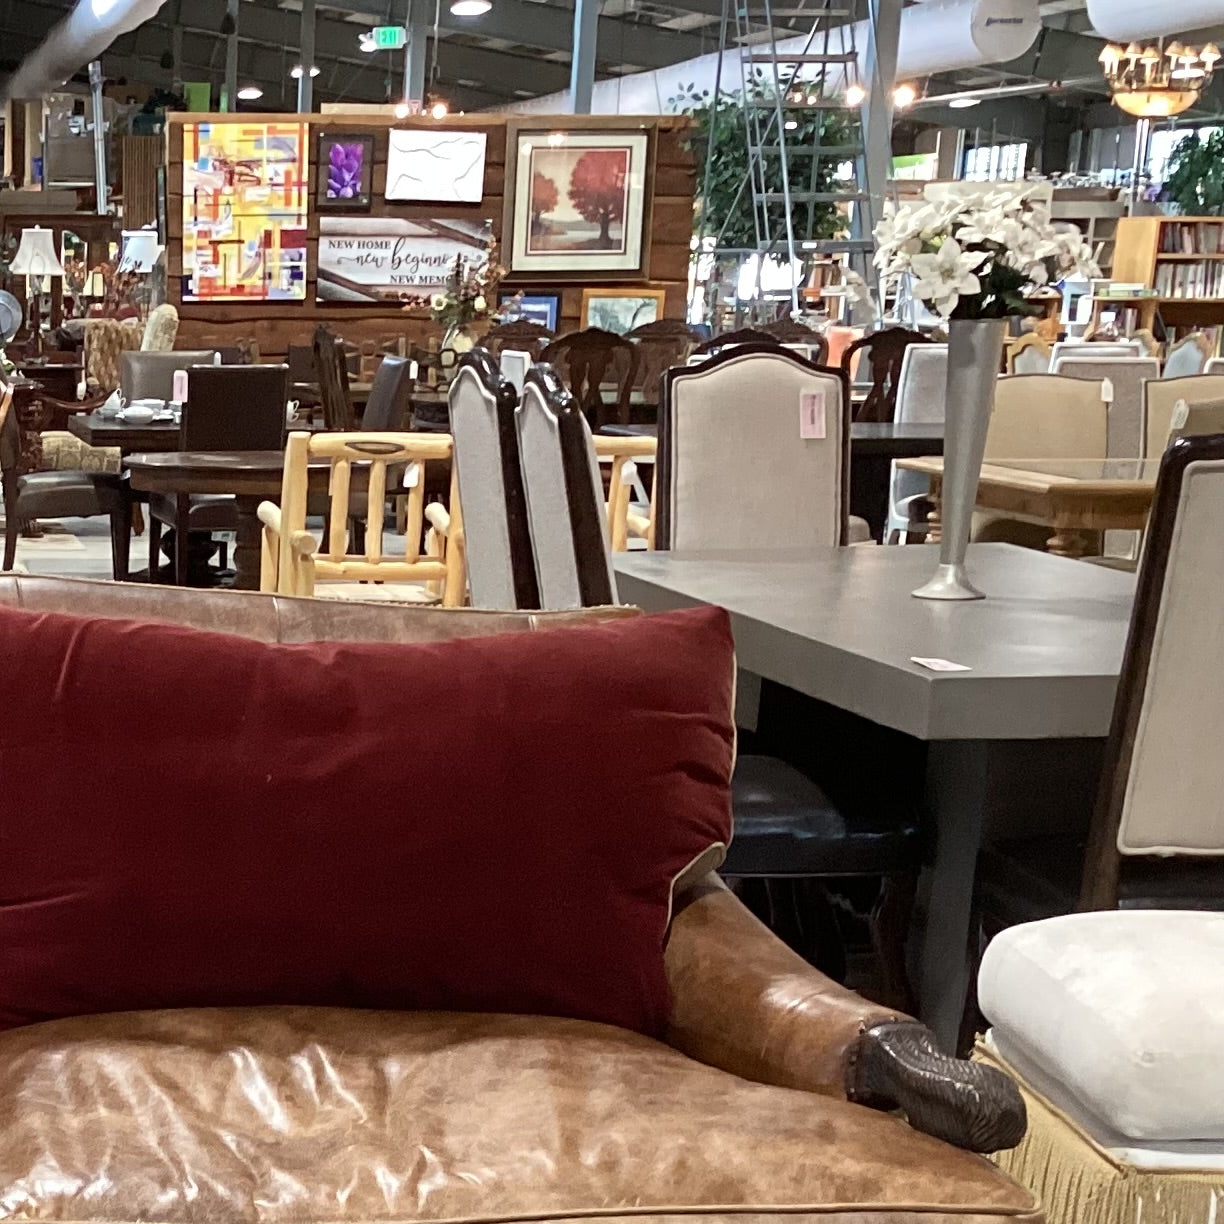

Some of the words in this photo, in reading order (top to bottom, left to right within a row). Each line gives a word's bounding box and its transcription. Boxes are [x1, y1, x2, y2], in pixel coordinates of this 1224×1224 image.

[328, 239, 354, 249] NEW
[356, 239, 391, 250] HOME
[337, 252, 388, 268] new
[389, 274, 416, 285] NEW
